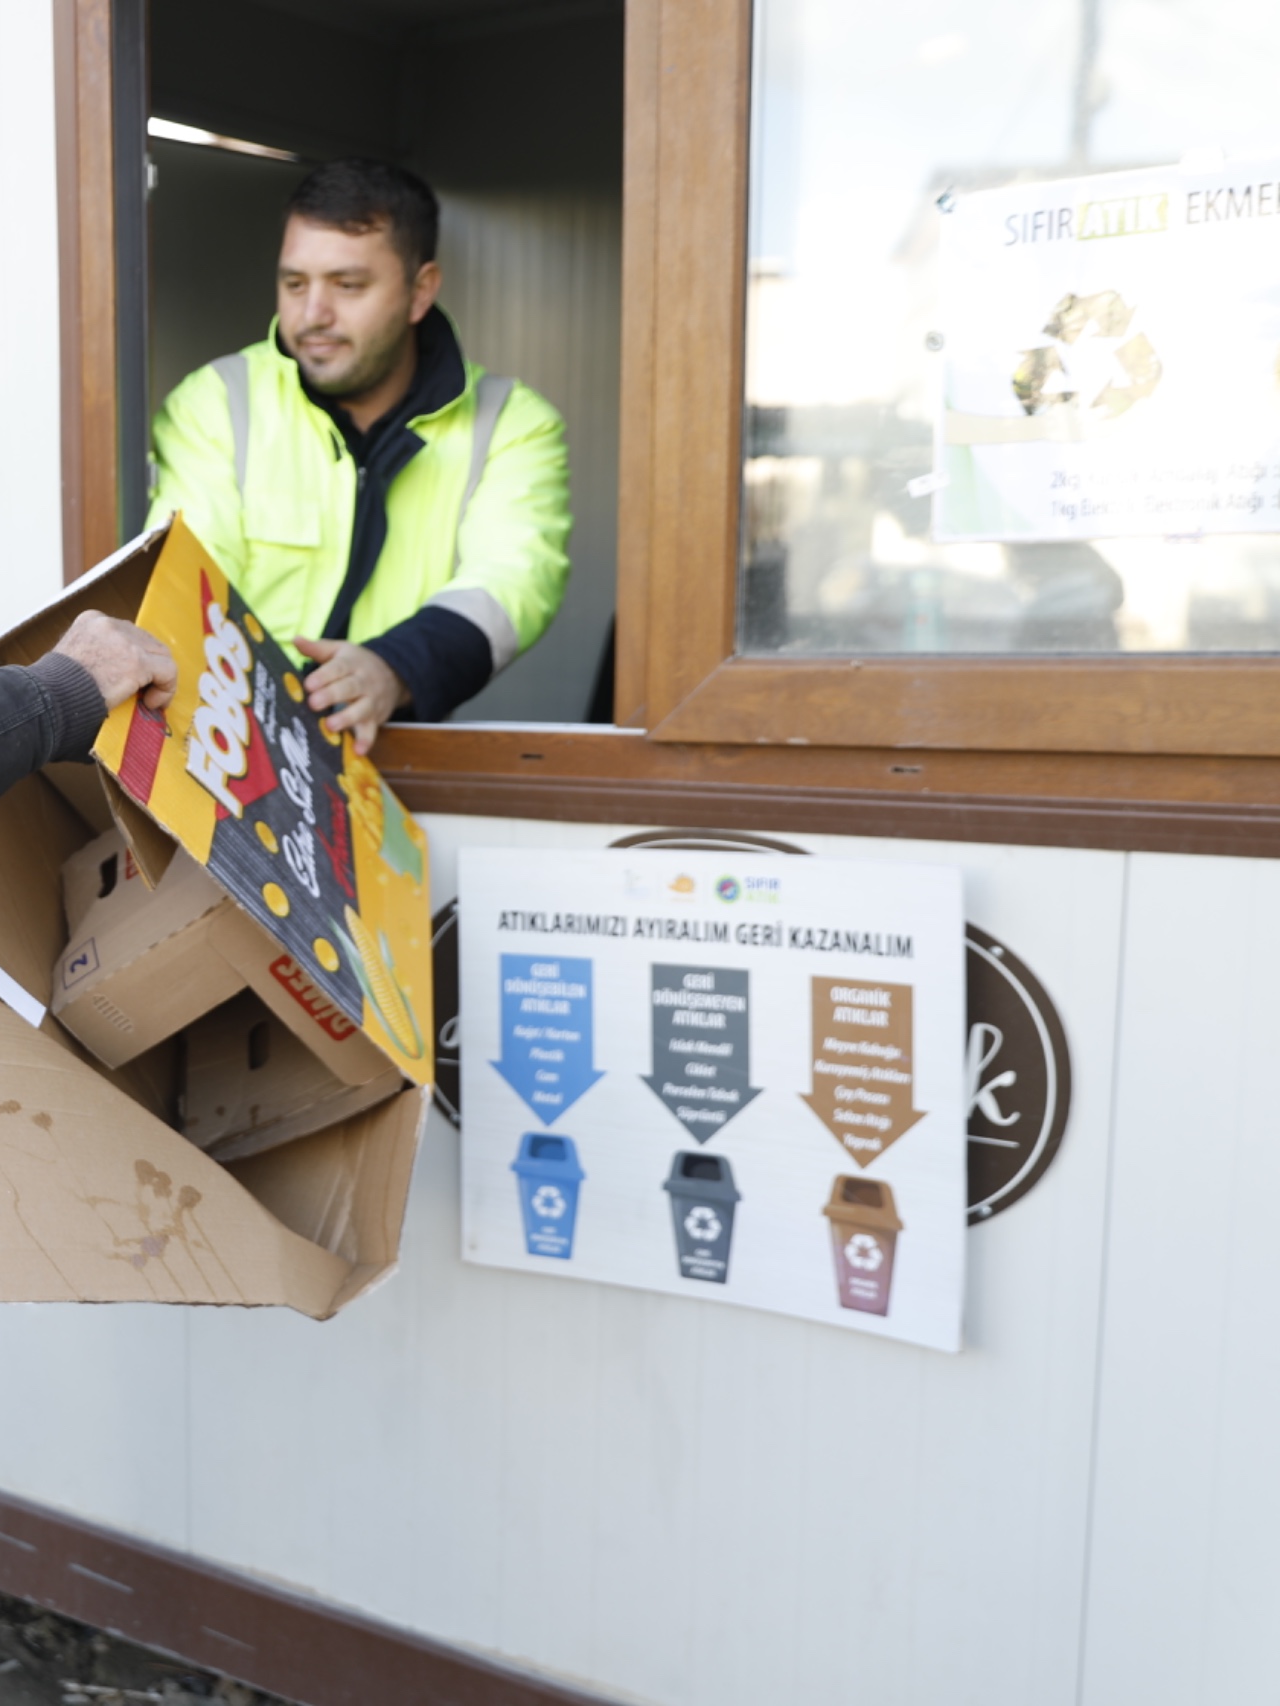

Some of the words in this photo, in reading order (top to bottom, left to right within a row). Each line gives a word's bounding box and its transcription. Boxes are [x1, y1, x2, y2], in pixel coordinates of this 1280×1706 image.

[1004, 205, 1075, 247] SIFIR
[1077, 196, 1168, 238] ATIK
[1185, 181, 1280, 225] EKME
[185, 601, 252, 819] FOBOS
[70, 952, 87, 974] 2
[497, 909, 628, 938] ATIKLARIMIZI
[632, 916, 731, 944] AYIRALIM
[735, 920, 783, 948] GERİ
[788, 926, 915, 959] KAZANALIM
